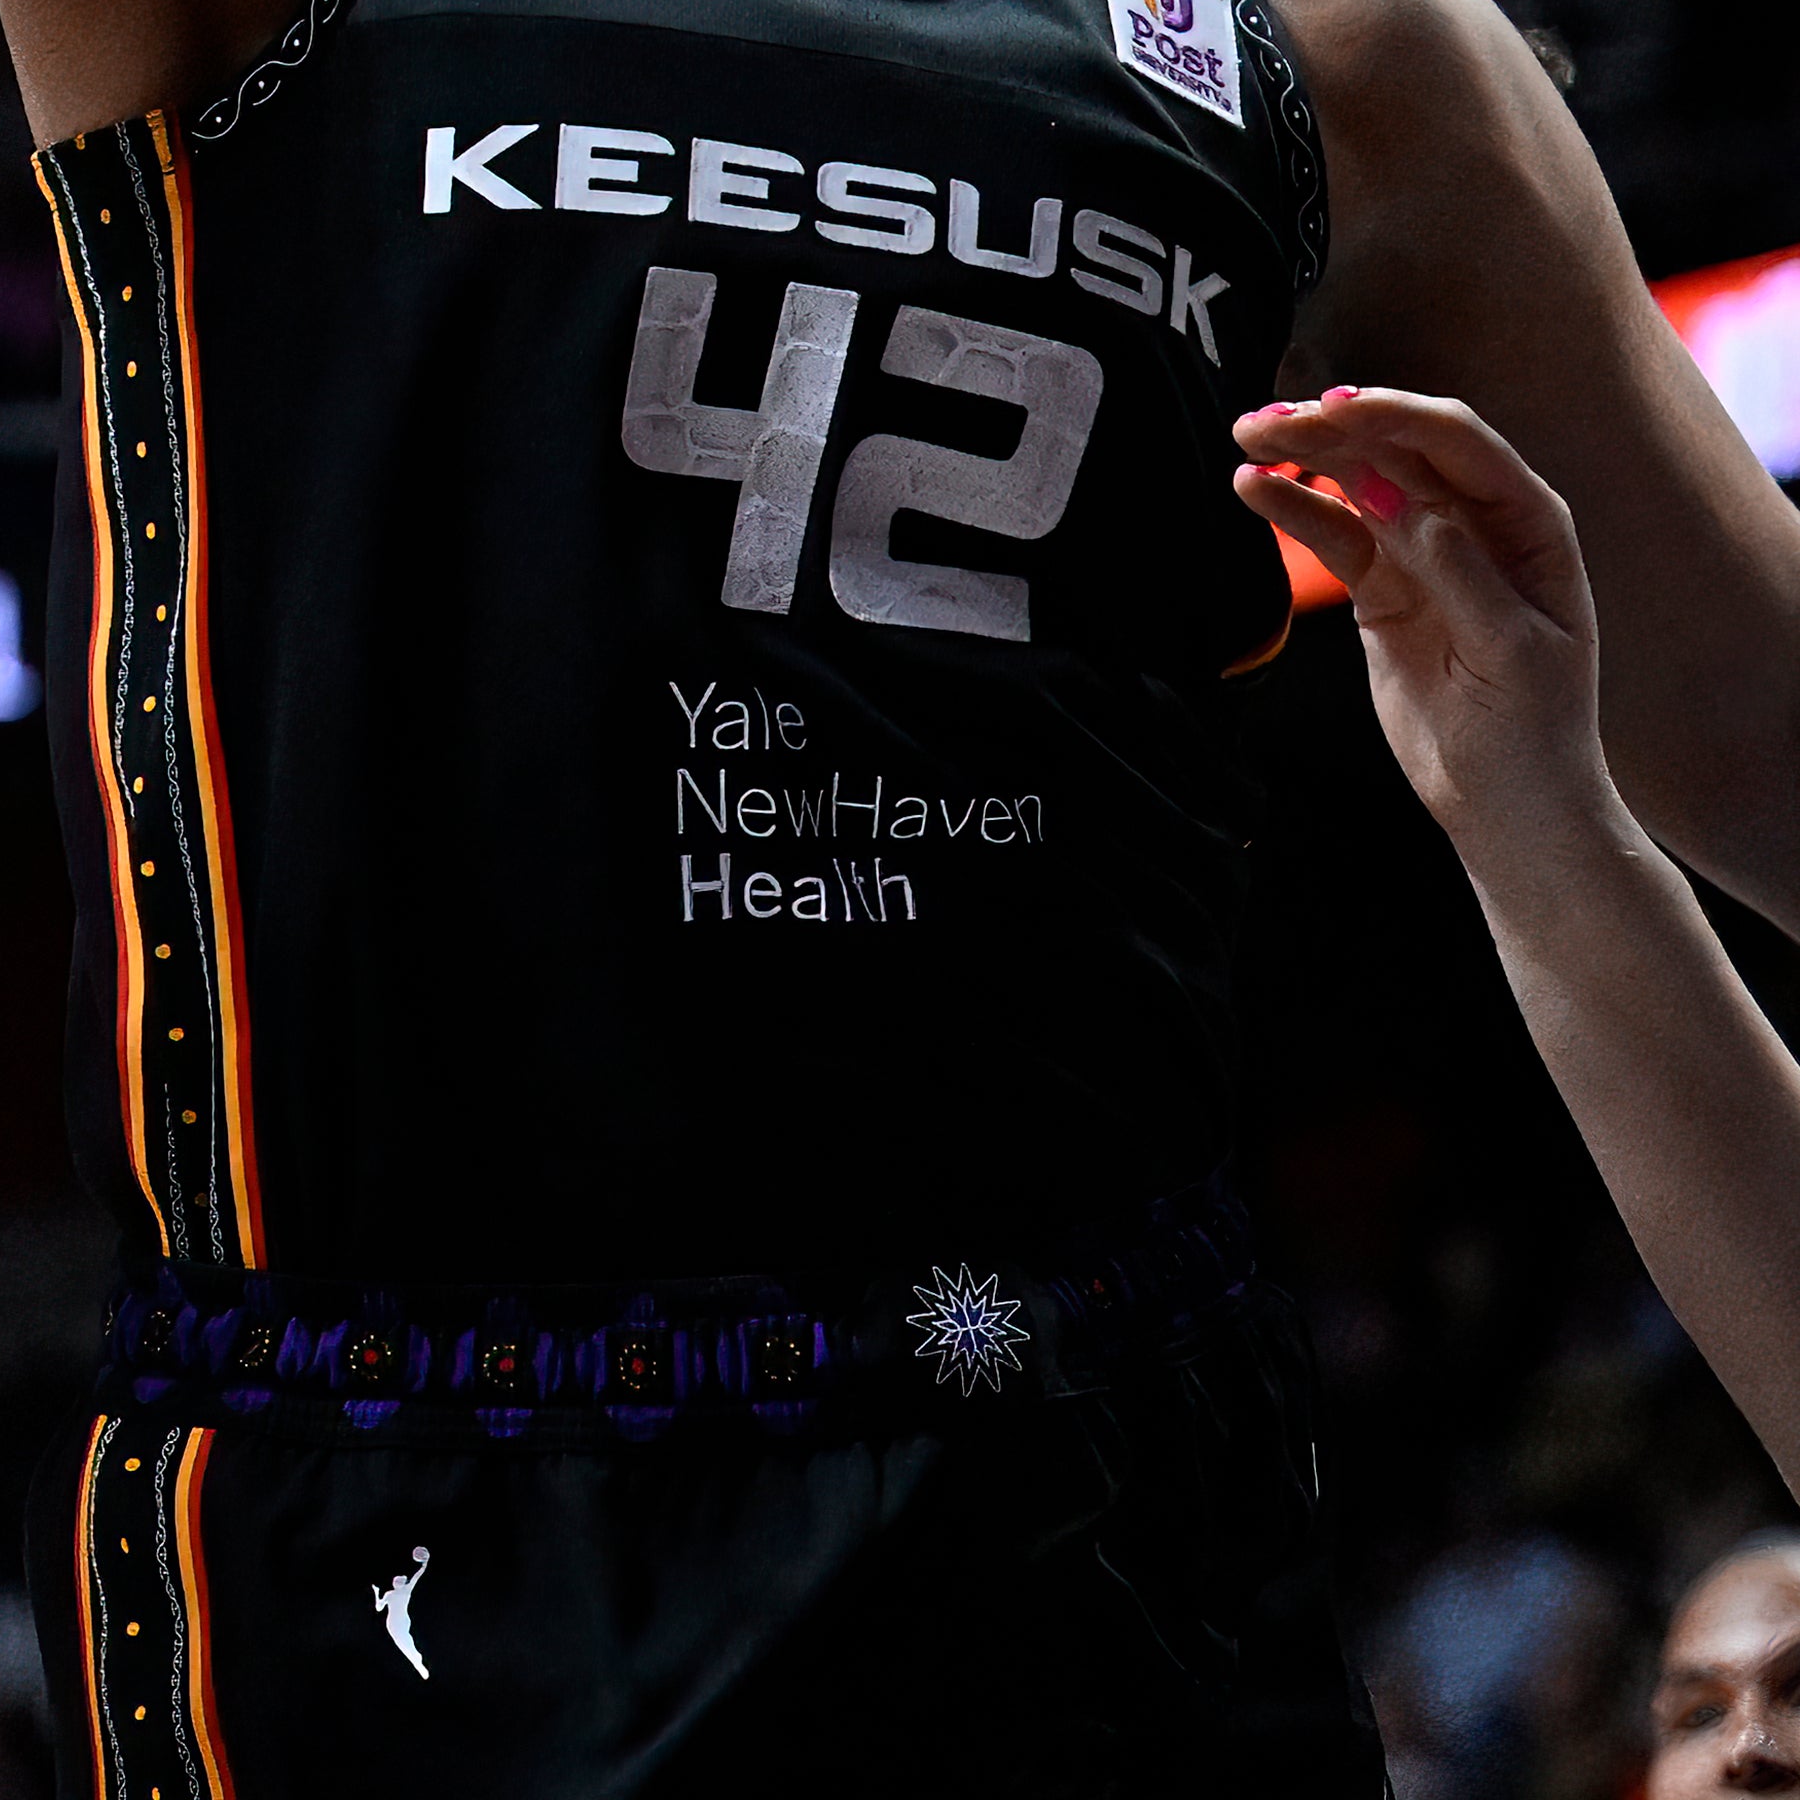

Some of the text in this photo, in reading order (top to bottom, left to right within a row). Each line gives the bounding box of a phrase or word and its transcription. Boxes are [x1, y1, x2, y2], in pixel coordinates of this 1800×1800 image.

[422, 122, 1232, 369] KEESUSK
[620, 265, 1105, 643] 42
[668, 680, 808, 752] Yale
[675, 767, 1046, 846] NewHaven
[682, 850, 919, 924] Health
